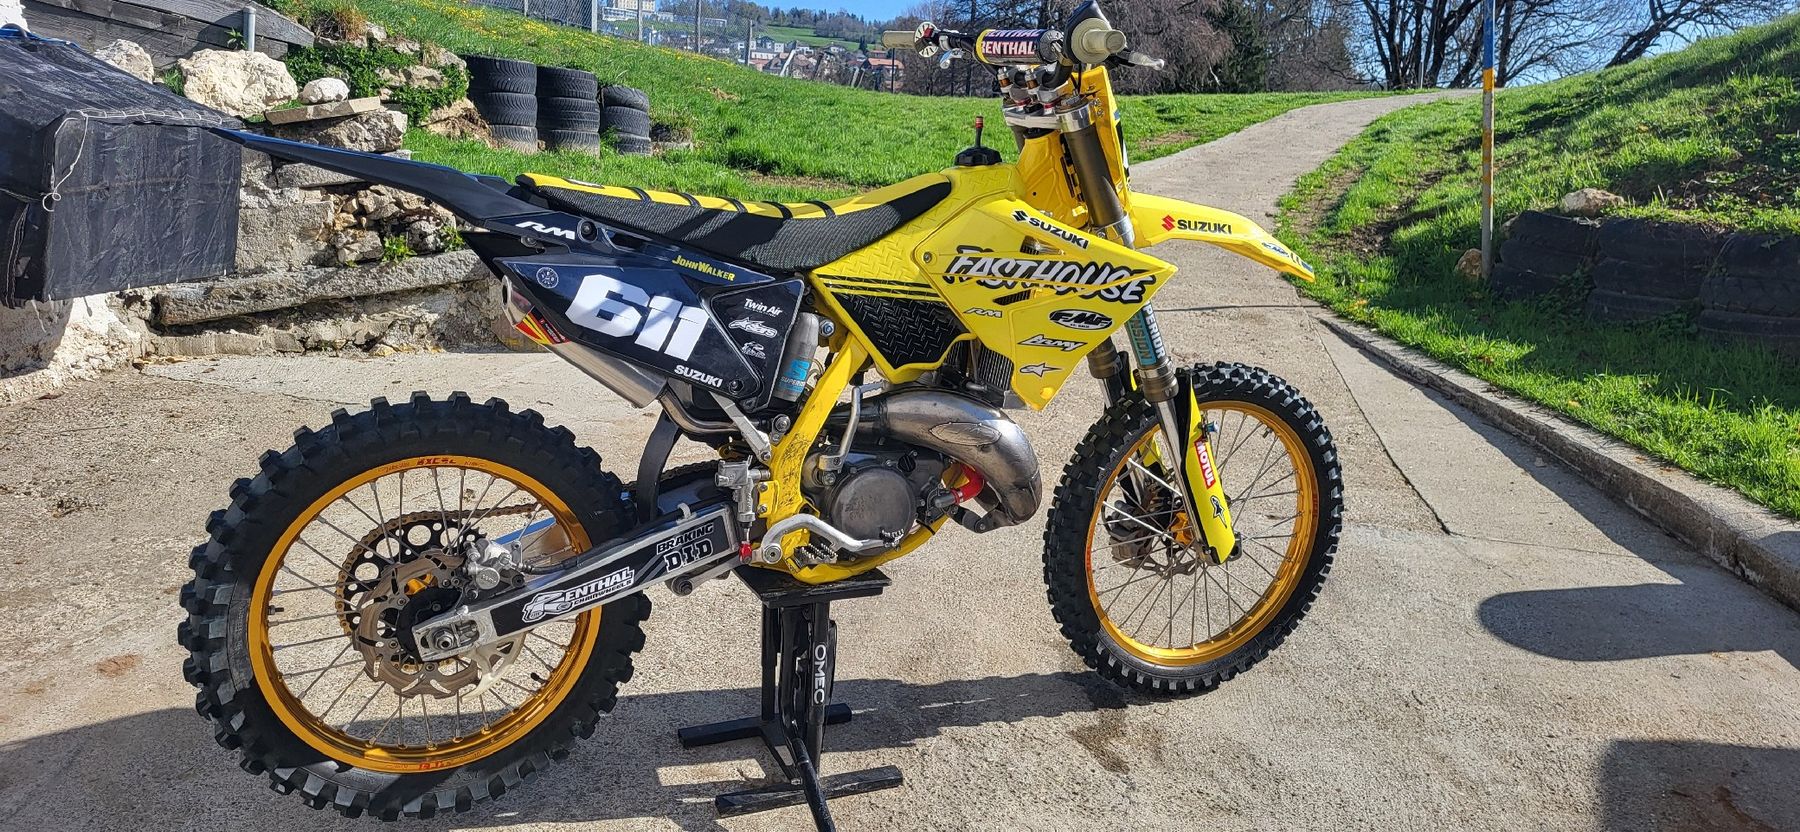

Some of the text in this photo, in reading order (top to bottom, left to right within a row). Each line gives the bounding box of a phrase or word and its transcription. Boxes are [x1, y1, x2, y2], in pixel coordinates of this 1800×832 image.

[1028, 217, 1089, 250] SUZUKI
[1177, 219, 1232, 234] SUZUKI
[943, 245, 1157, 303] FASTHOUSE
[564, 273, 711, 361] 611
[744, 298, 767, 312] Twin
[767, 306, 783, 316] Air
[673, 364, 723, 388] SUZUKI
[656, 522, 714, 556] BRAKING
[814, 644, 827, 705] OMEC
